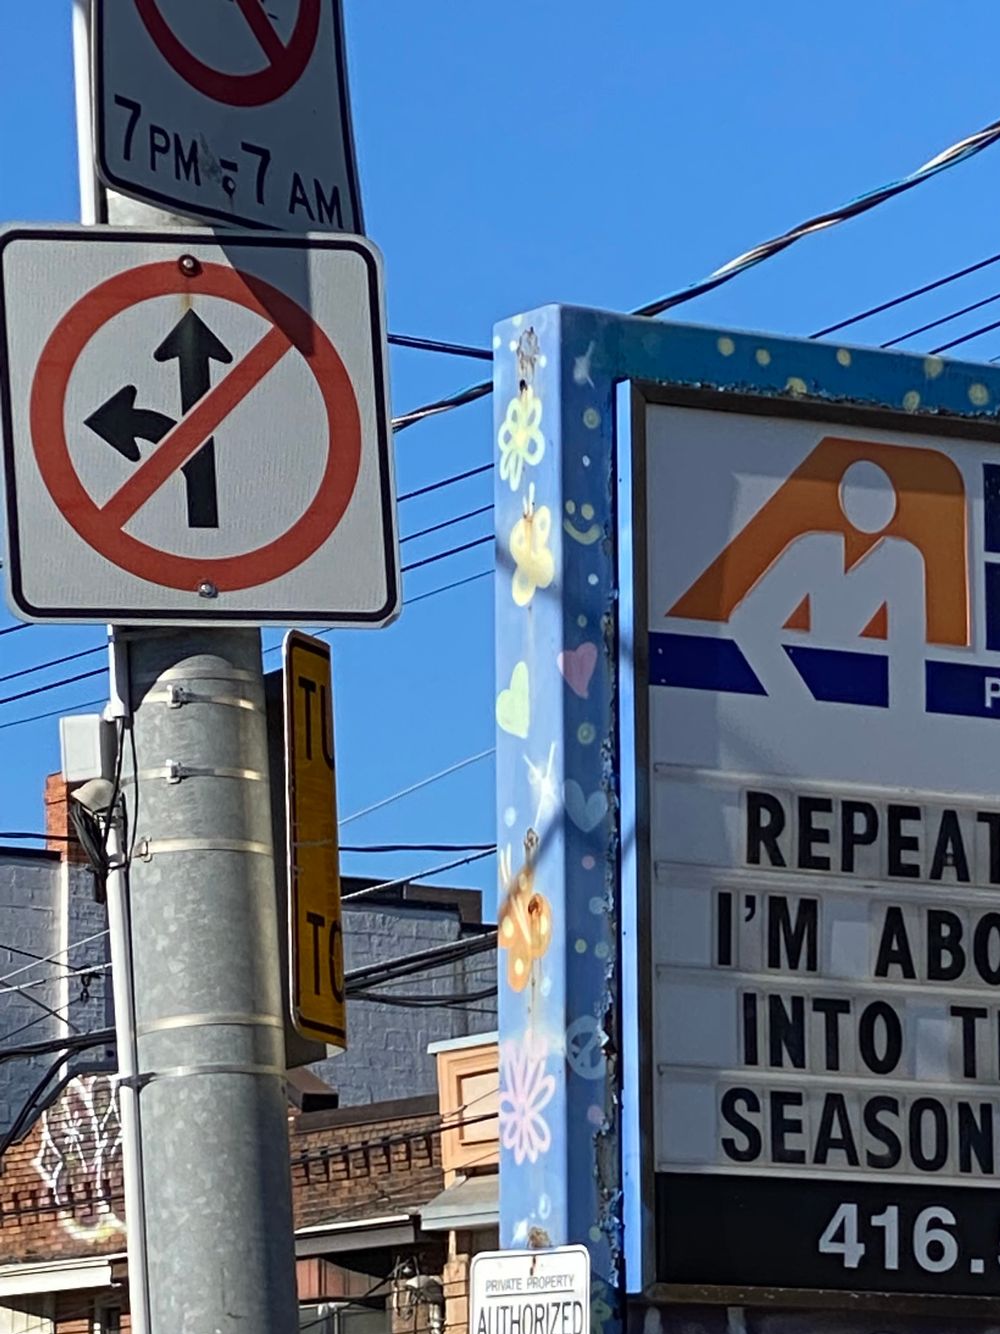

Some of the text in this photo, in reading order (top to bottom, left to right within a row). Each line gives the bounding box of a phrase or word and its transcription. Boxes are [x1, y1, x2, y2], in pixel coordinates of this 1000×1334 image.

[717, 891, 818, 973] I'M
[742, 991, 904, 1075] INTO
[720, 1087, 995, 1175] SEASON
[485, 1274, 575, 1292] PRIVATE PROPERTY
